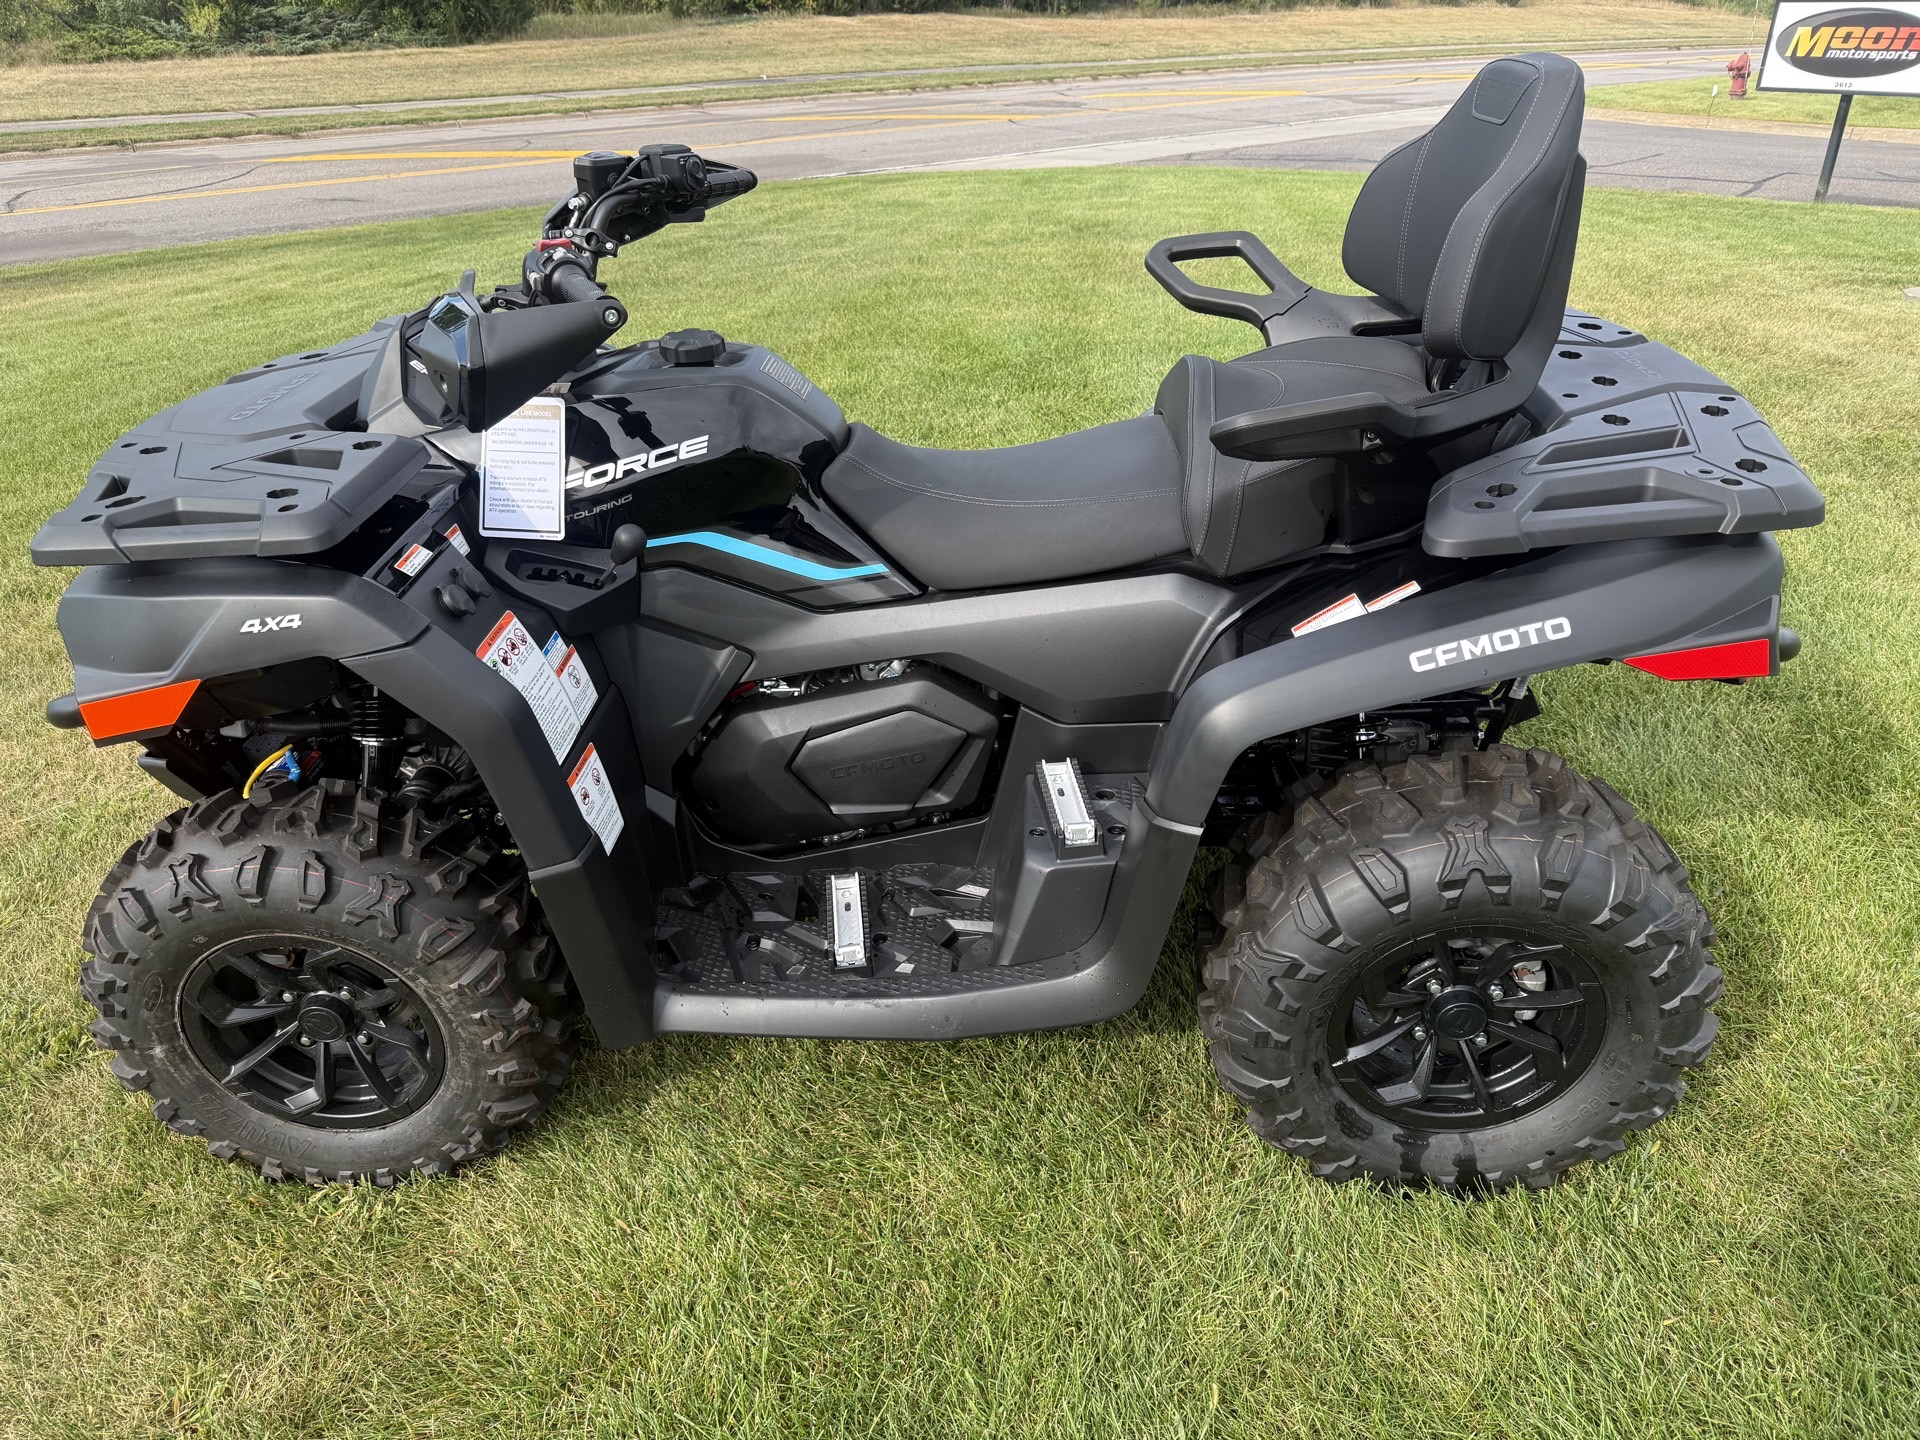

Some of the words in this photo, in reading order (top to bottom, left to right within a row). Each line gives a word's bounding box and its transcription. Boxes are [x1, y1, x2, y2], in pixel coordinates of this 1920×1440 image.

[1825, 49, 1918, 61] motorsports
[1408, 616, 1573, 673] CFMOTO
[830, 751, 926, 780] CFMOTO
